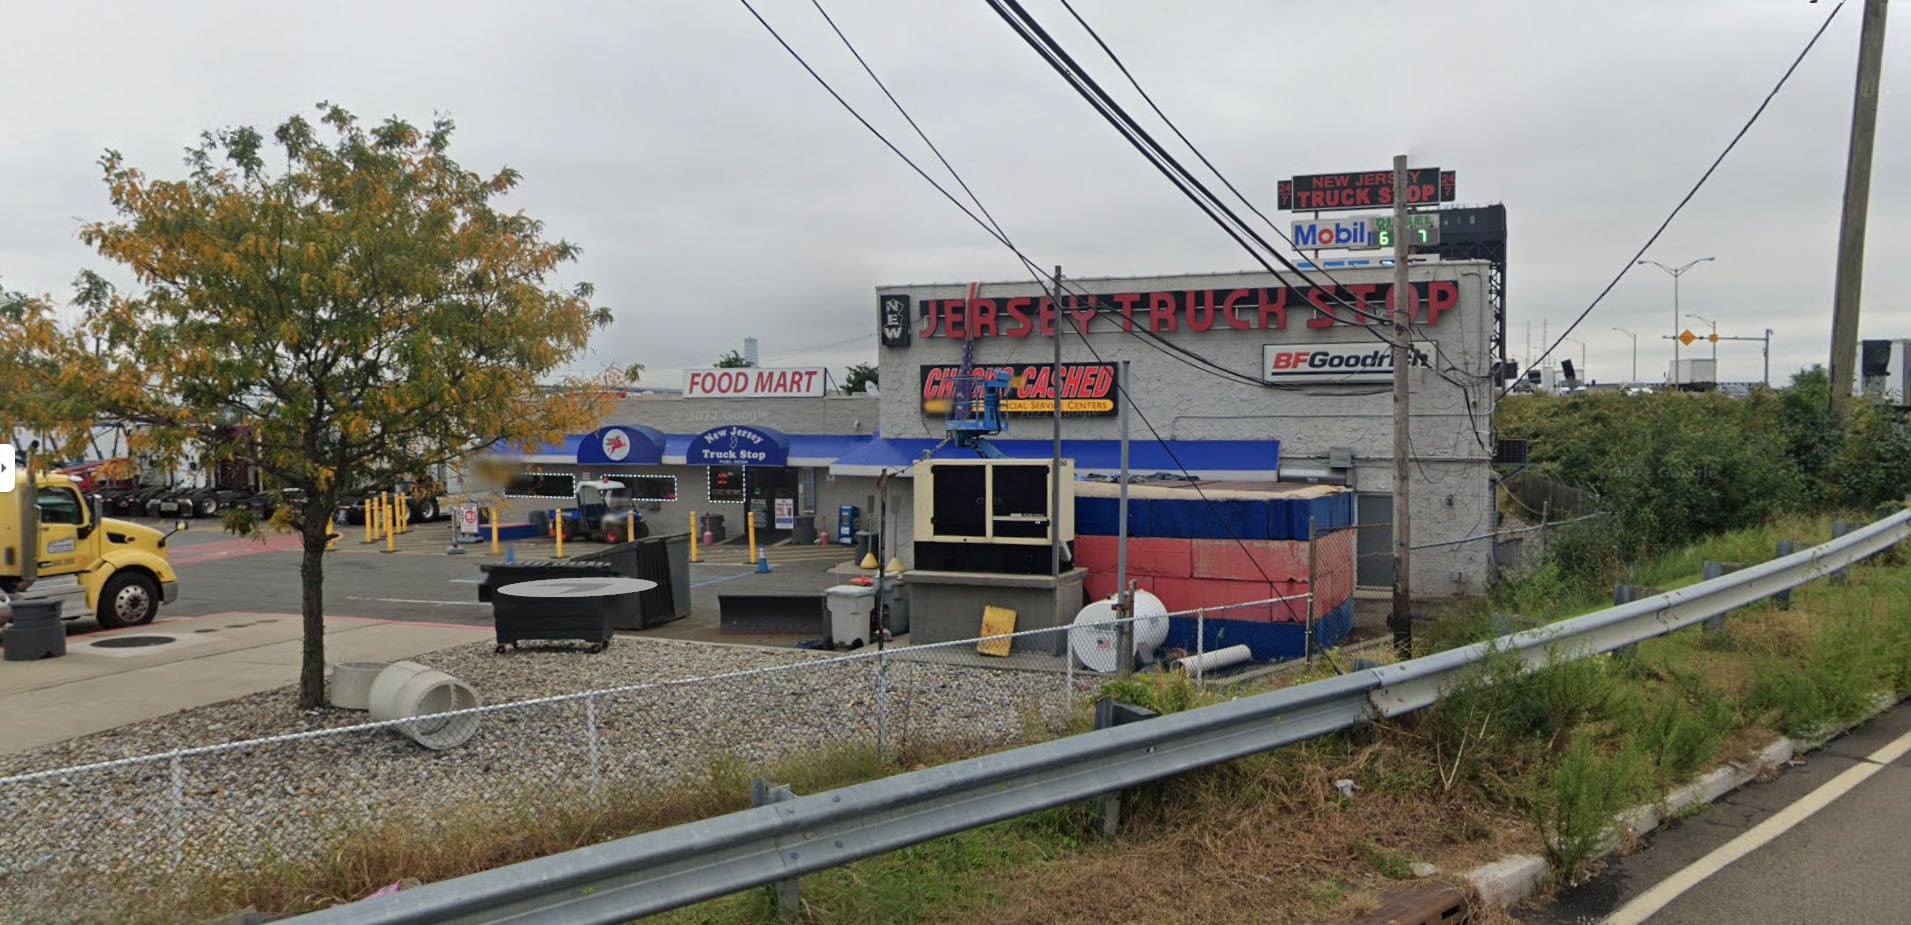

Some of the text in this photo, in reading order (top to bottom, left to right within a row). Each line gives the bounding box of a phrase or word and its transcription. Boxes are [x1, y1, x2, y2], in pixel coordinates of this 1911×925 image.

[1312, 171, 1421, 188] NEW JERSY
[1298, 184, 1435, 207] TRUCK SOP
[1294, 222, 1365, 246] Mobil
[884, 300, 901, 339] NEW
[919, 294, 1097, 338] JERSEY
[1114, 287, 1287, 334] TRUCK
[689, 370, 818, 394] FOOD MART
[1067, 401, 1107, 410] CENTERS
[703, 427, 763, 444] New Jersey
[702, 449, 766, 461] Truck Stop
